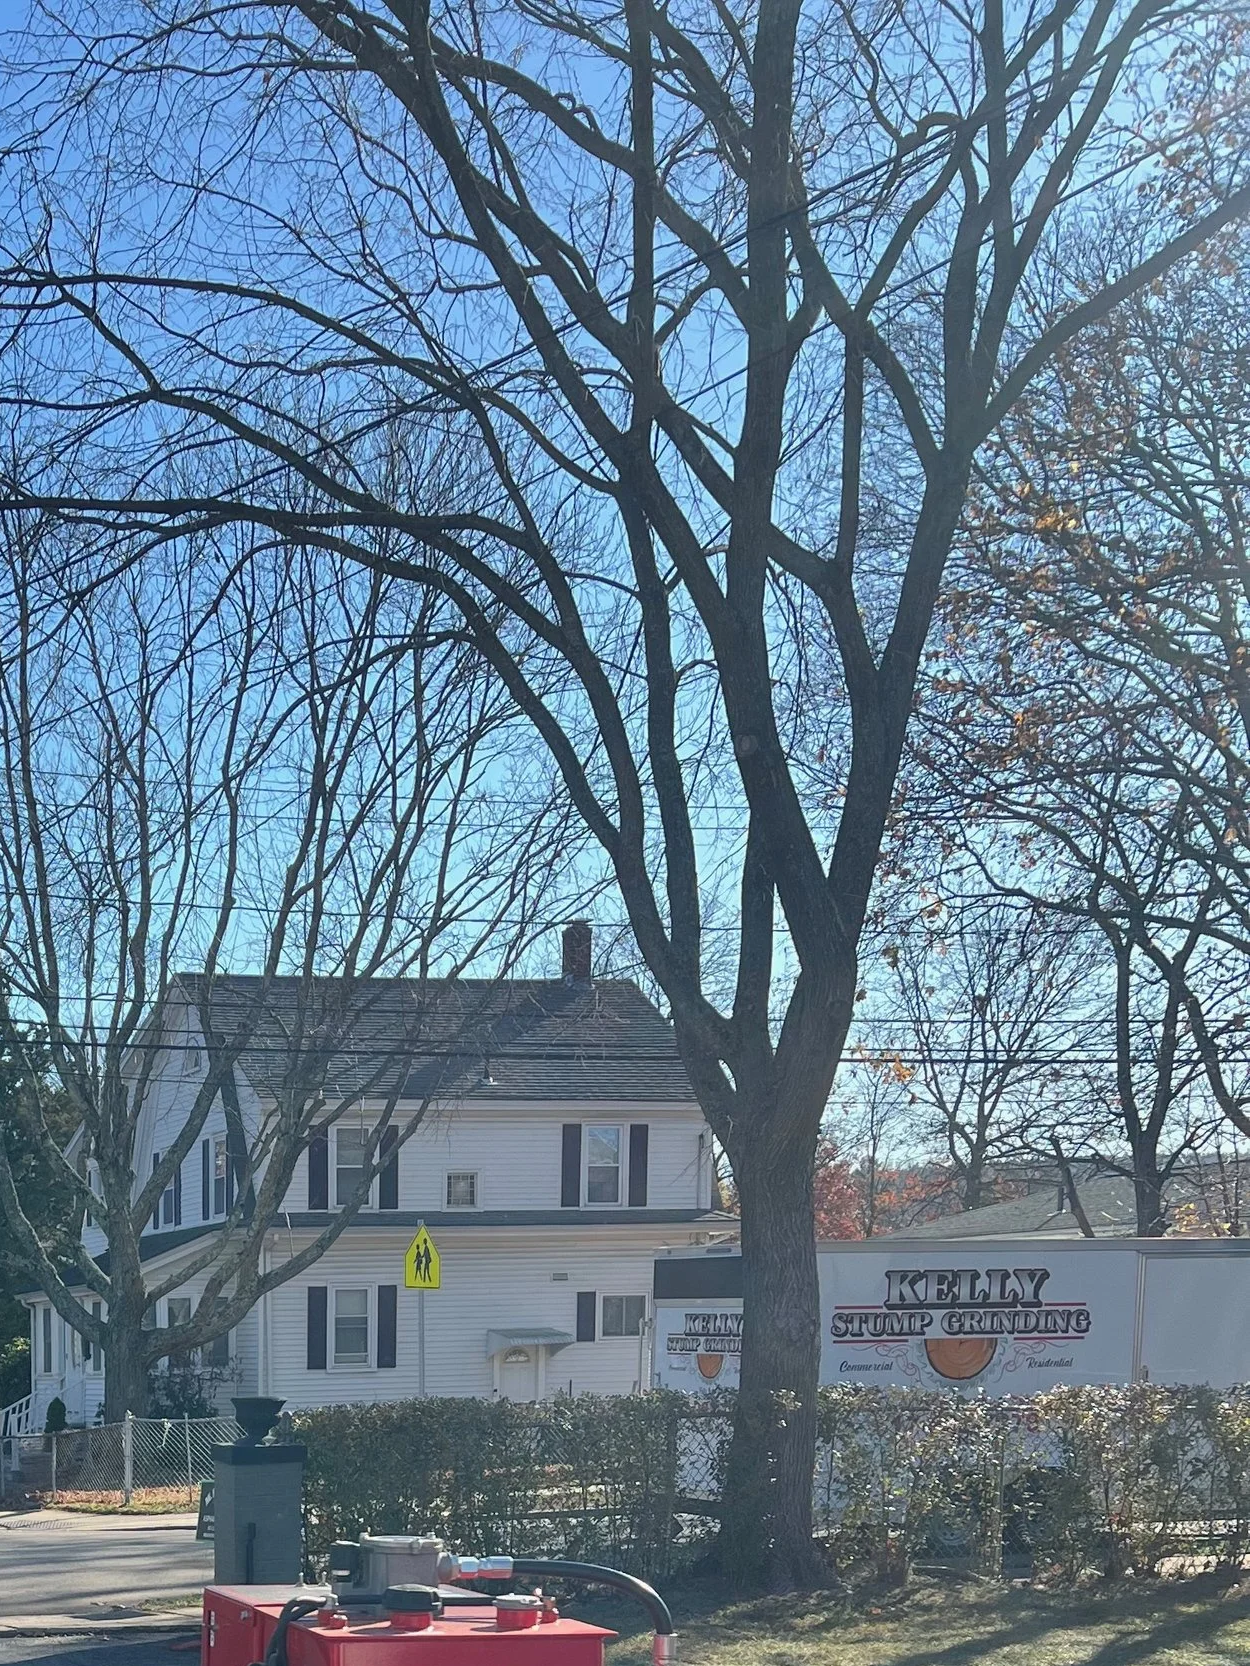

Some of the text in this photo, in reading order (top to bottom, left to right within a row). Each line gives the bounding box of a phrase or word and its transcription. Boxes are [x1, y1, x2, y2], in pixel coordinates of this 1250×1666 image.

[883, 1269, 1050, 1309] KELLY
[684, 1313, 742, 1337] KELLY
[831, 1309, 1092, 1337] STUMP GRINDING
[667, 1337, 742, 1353] STUMP GRINDI
[839, 1360, 894, 1373] Commercial
[1026, 1357, 1074, 1369] Residential
